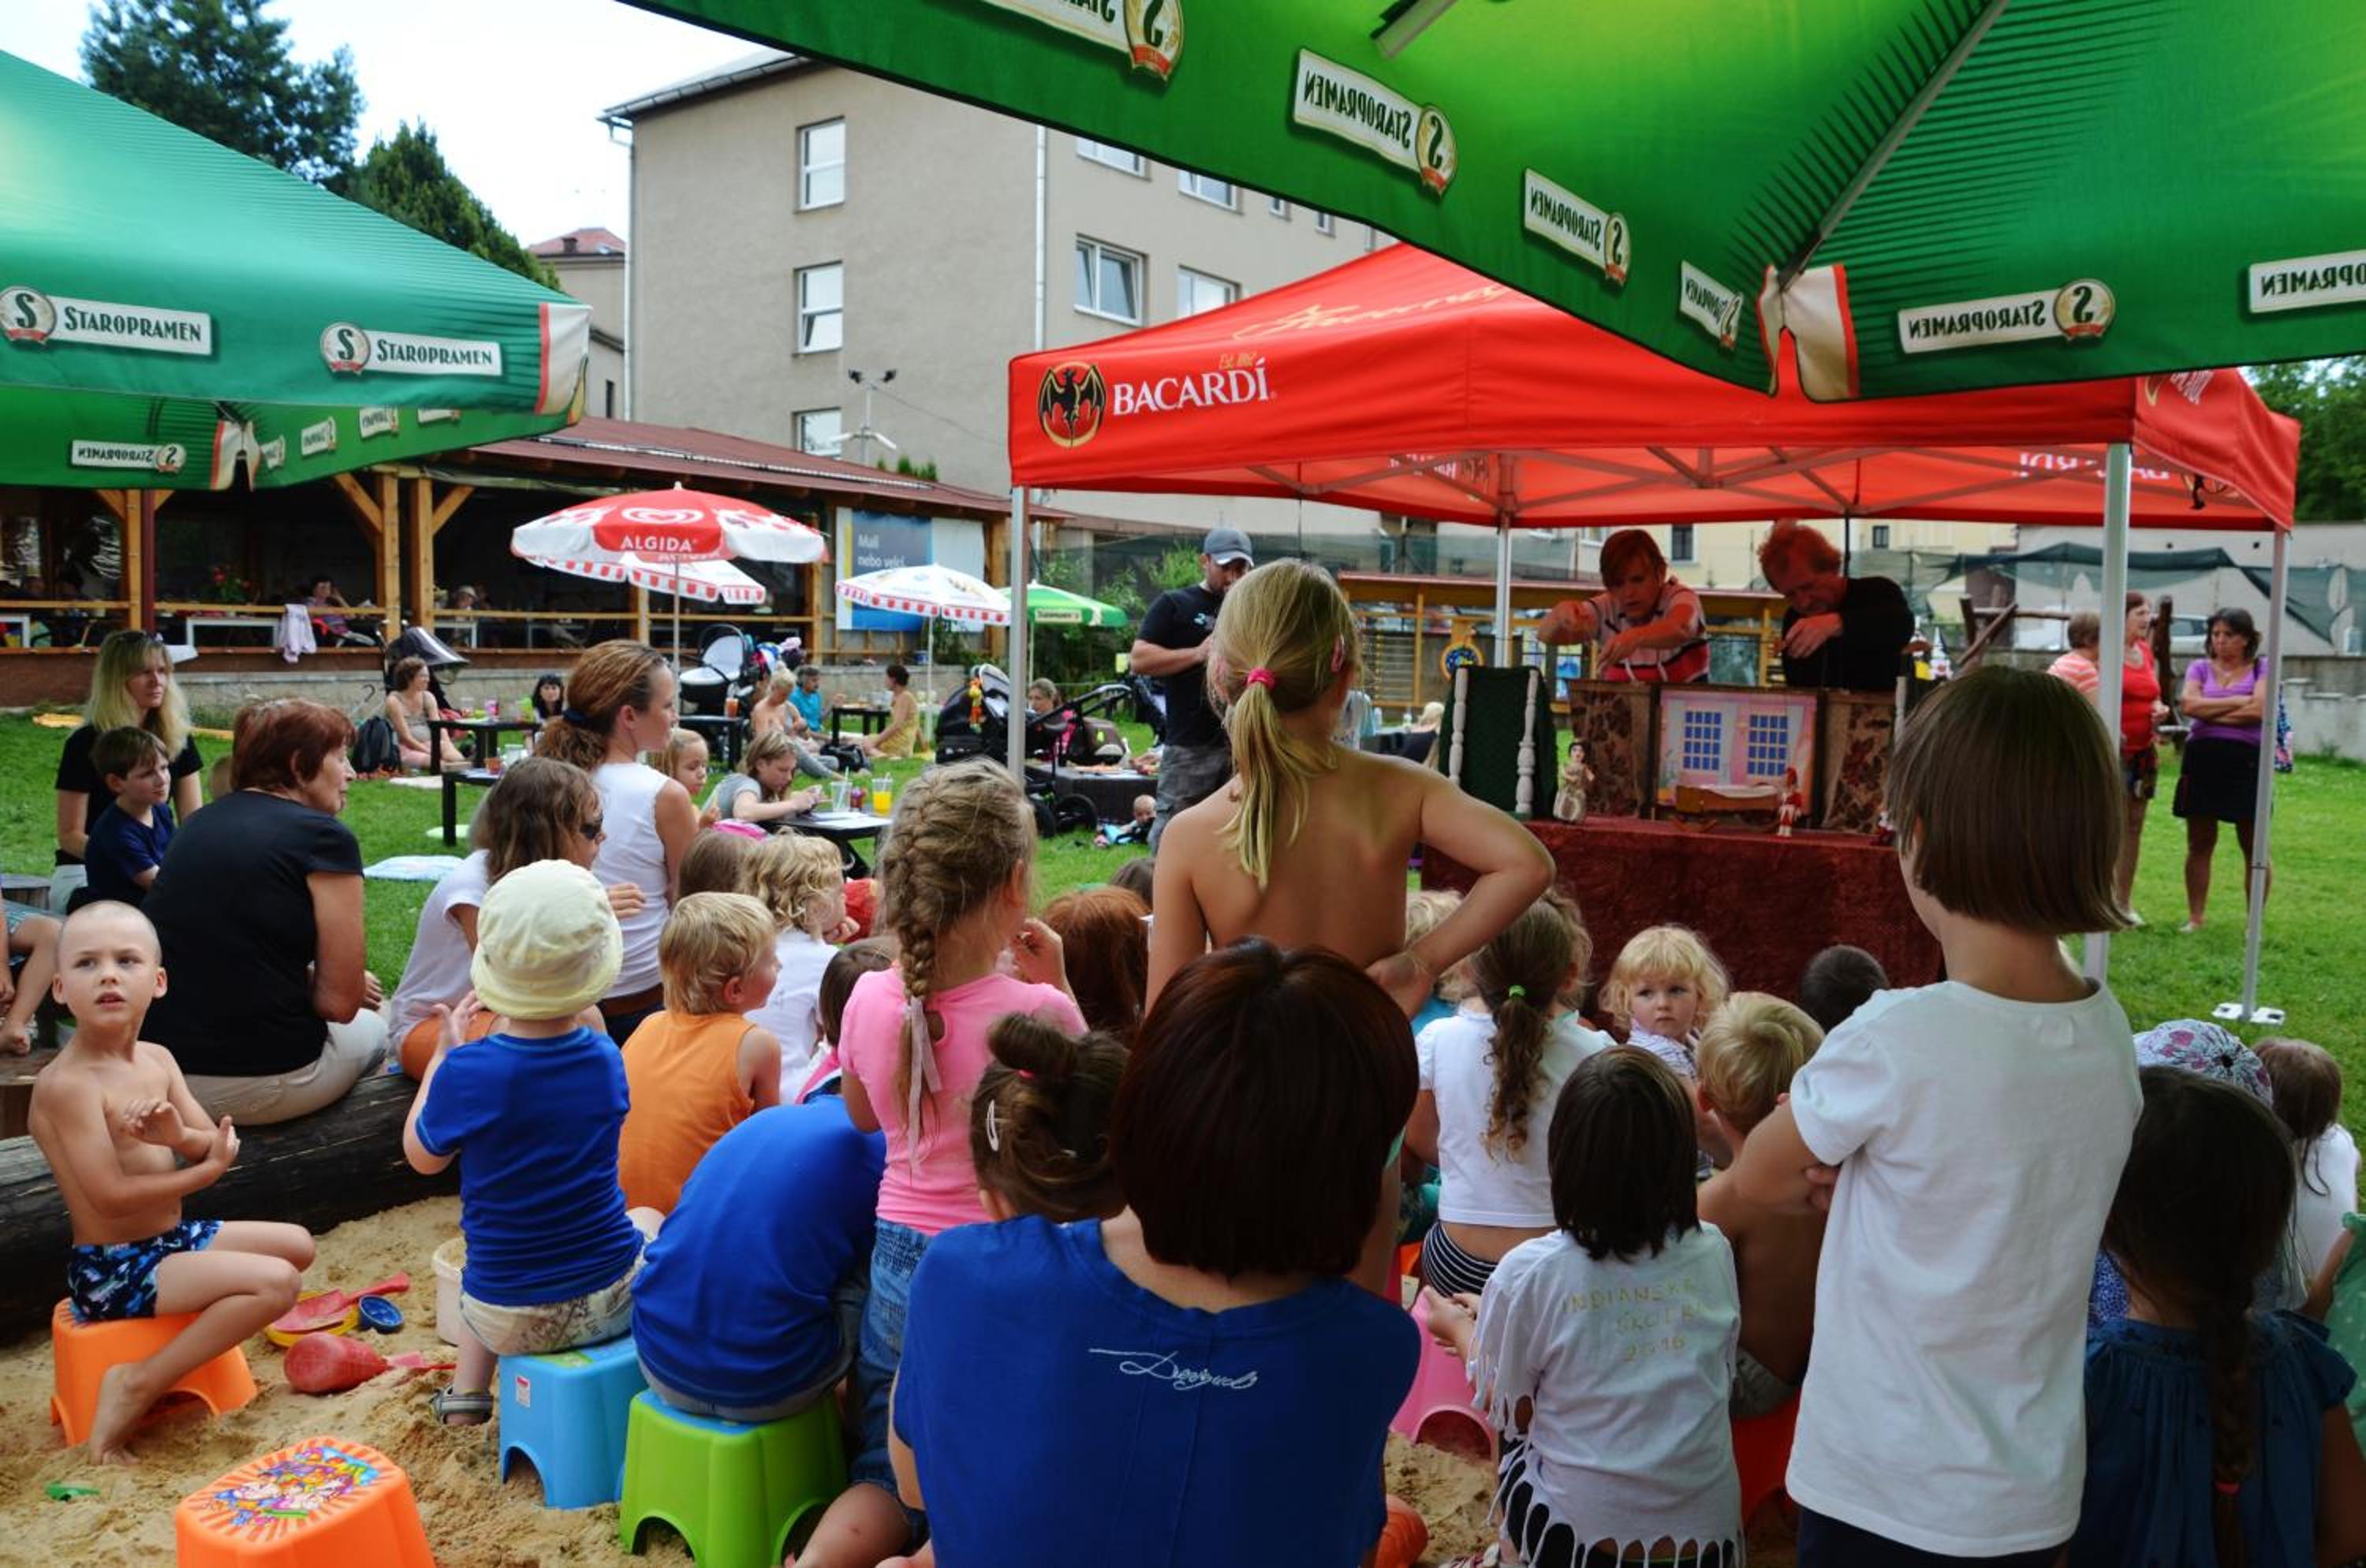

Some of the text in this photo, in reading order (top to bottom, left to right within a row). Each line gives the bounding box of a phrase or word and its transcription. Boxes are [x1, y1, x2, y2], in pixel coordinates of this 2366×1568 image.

[15, 293, 202, 342] S STAROPRAMEN
[337, 328, 493, 364] S STAROPRAMEN
[1112, 357, 1269, 416] BACARDÍ
[619, 534, 692, 552] ALGIDA
